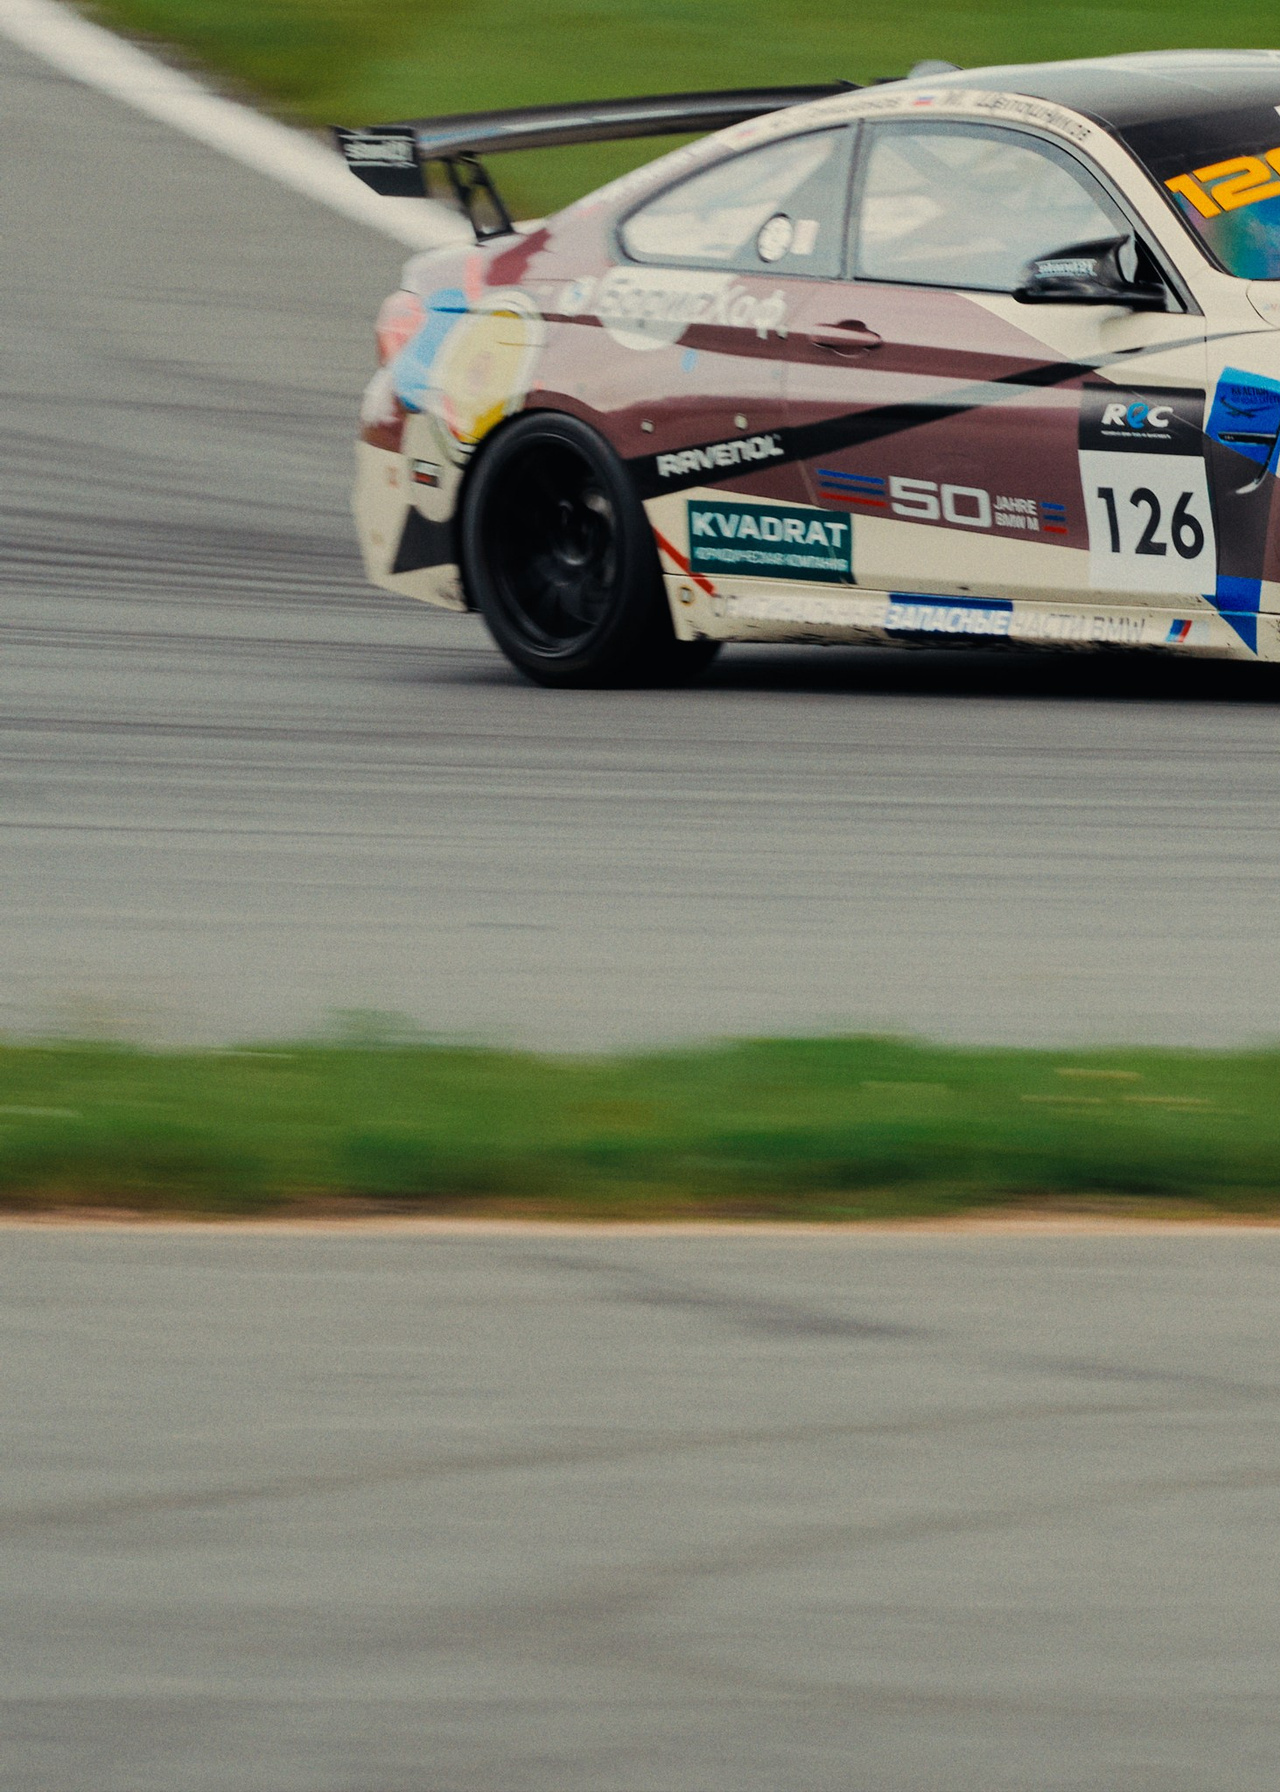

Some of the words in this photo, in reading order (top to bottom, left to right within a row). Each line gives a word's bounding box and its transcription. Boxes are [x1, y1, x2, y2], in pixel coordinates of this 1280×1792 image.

[656, 435, 785, 478] RAVENOL
[888, 475, 993, 528] 50
[993, 495, 1038, 516] JAHRE
[1098, 487, 1205, 559] 126
[691, 511, 848, 548] KVADRAT
